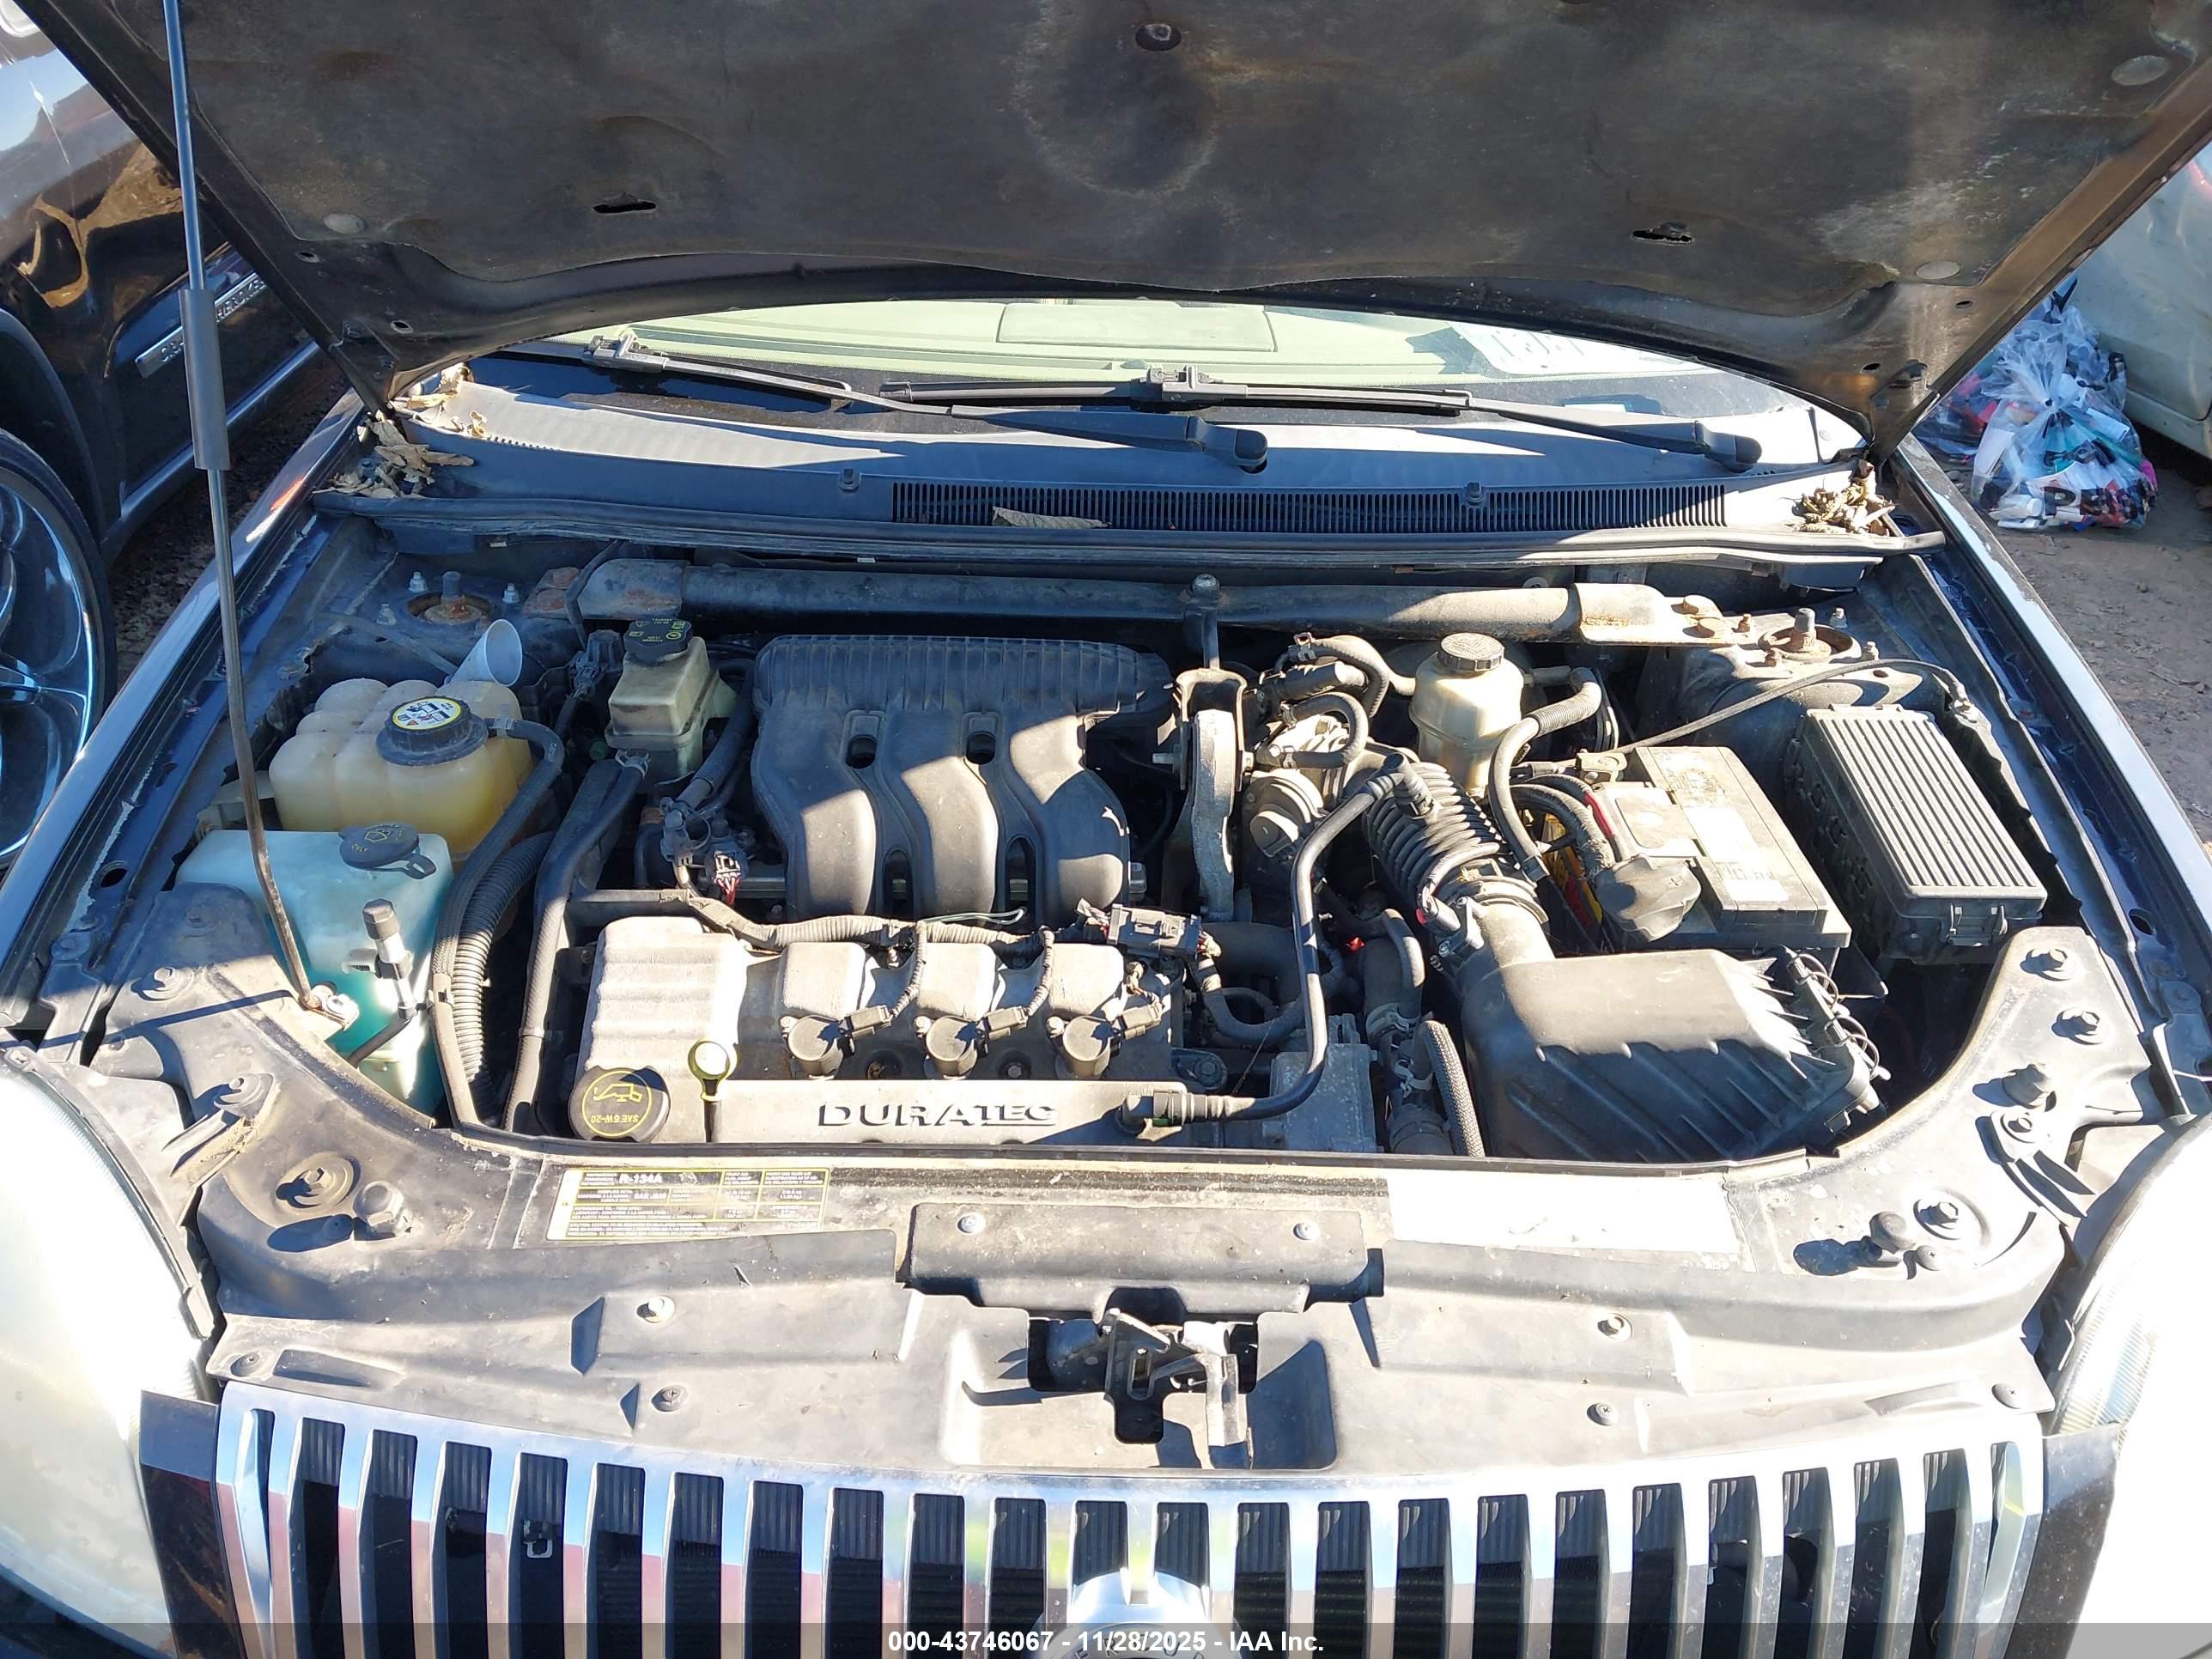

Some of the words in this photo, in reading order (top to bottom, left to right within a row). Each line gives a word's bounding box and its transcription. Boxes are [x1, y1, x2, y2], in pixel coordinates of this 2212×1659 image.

[591, 1114, 620, 1124] 5W-20
[620, 1114, 640, 1123] SAE
[817, 1103, 1057, 1127] DURATEC
[618, 1173, 663, 1184] R-134A
